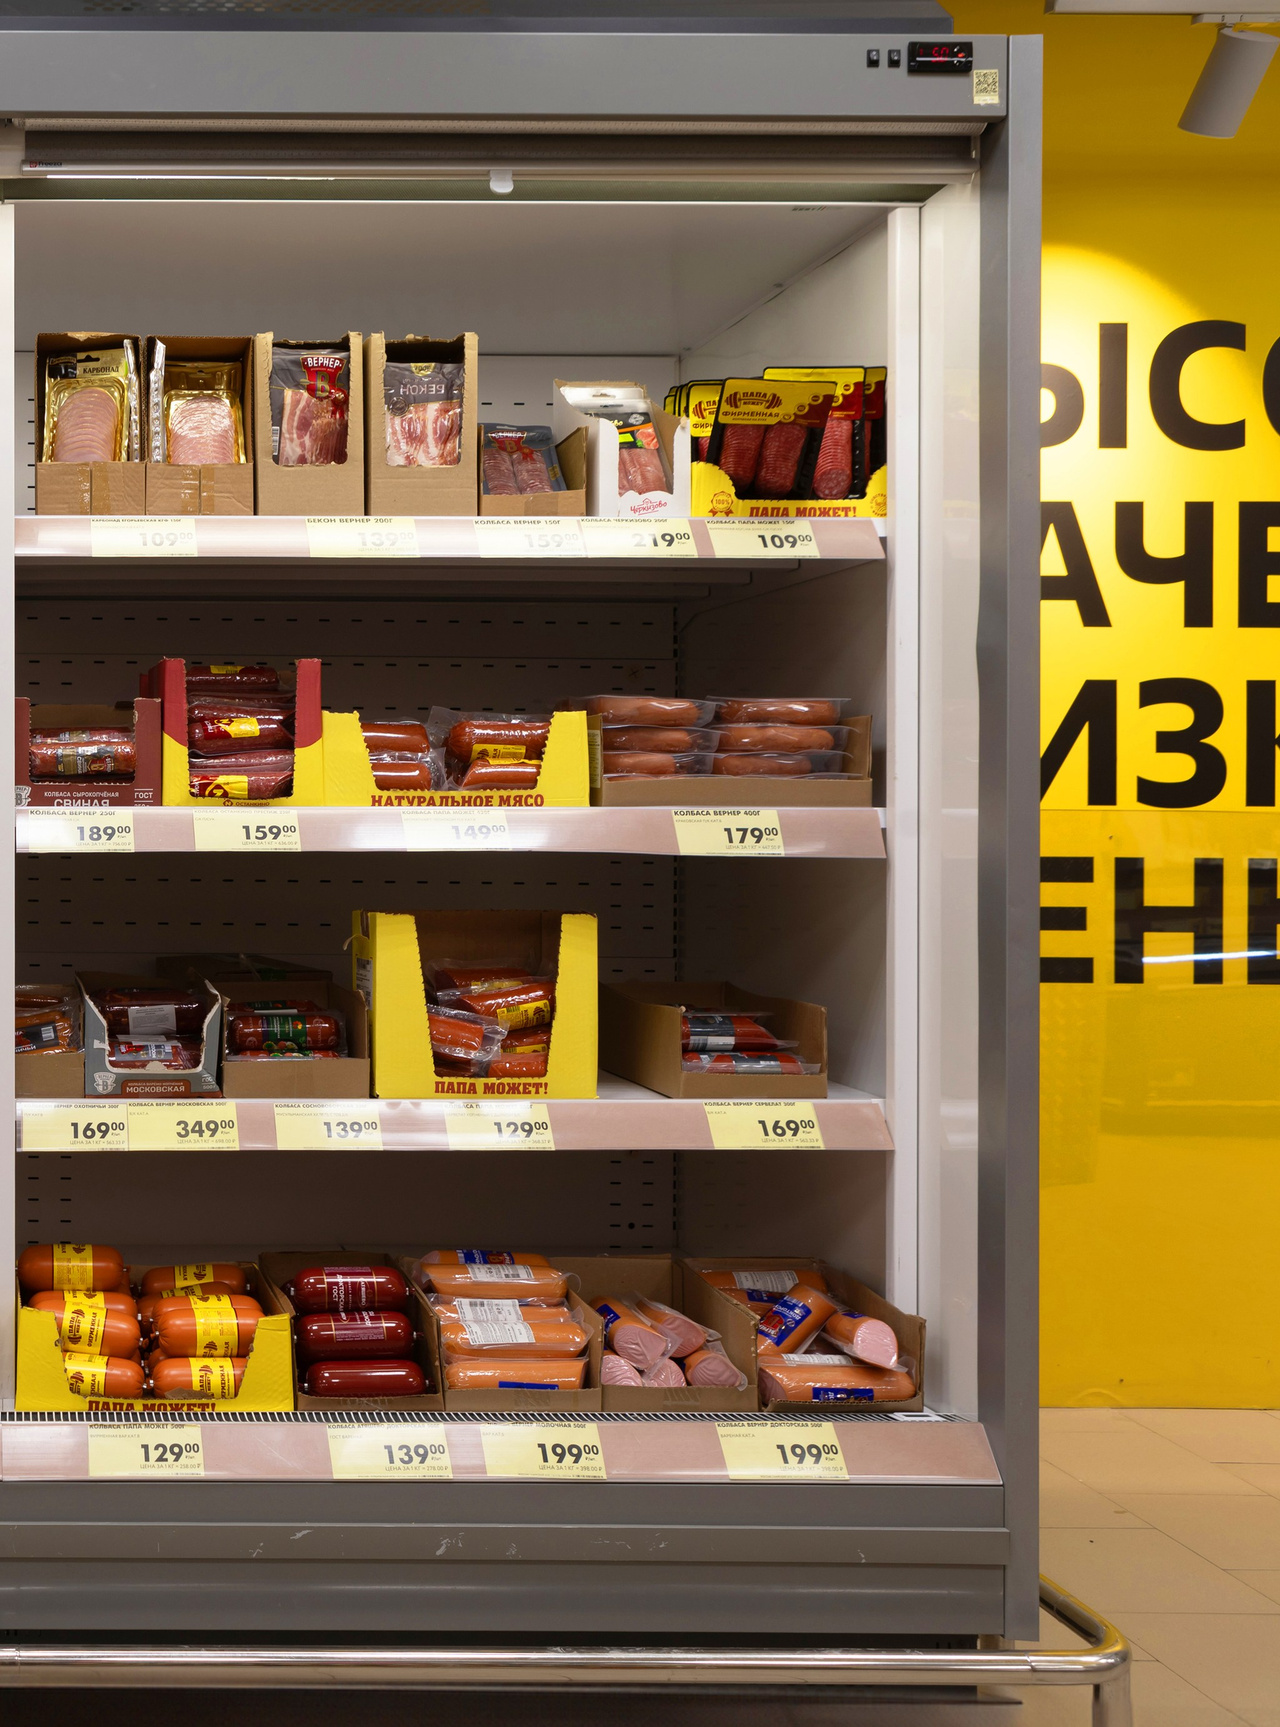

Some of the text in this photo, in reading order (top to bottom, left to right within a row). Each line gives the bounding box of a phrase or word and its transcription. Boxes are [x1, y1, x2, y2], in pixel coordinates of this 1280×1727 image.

[307, 357, 340, 368] ВЕРНЕР
[82, 366, 120, 374] КАРБОНАД
[749, 506, 858, 517] ПАПА МОЖЕТ!
[371, 794, 544, 806] НАТУРАЛЬНОЕ МЯСО
[126, 1086, 185, 1094] МОСКОВСКАЯ
[434, 1082, 549, 1095] ПАПА МОЖЕТ!
[87, 1312, 98, 1348] ФИРМЕННАЯ
[88, 1400, 134, 1412] ПАПА
